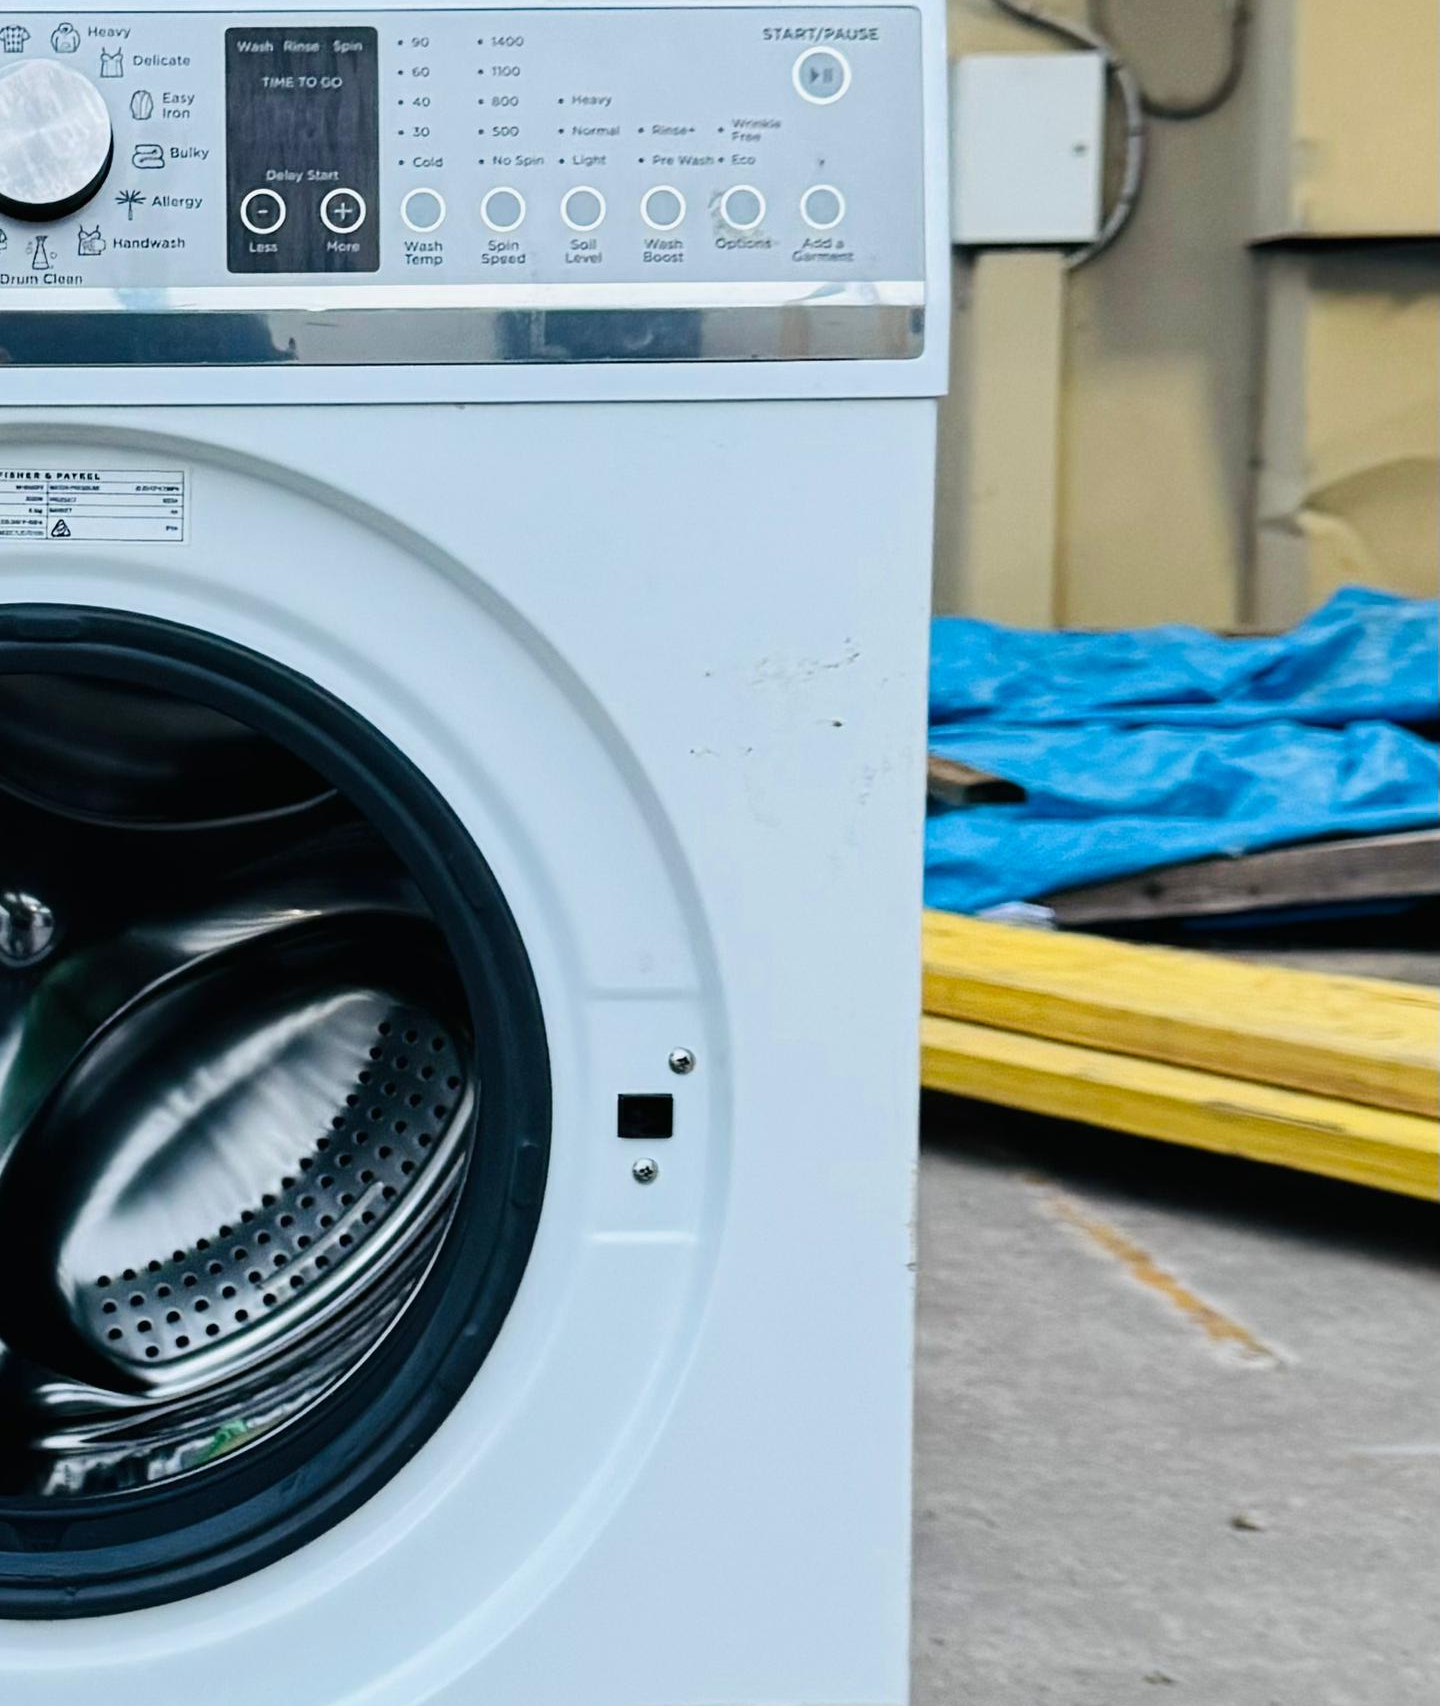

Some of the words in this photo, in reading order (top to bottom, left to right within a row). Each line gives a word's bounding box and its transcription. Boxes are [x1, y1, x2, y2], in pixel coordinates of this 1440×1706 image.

[88, 26, 131, 40] Heavy
[762, 27, 879, 42] START/PAUSE
[237, 41, 274, 53] Wash
[283, 41, 320, 53] Rinse
[333, 40, 363, 54] Spin
[492, 36, 525, 47] 1400
[132, 54, 191, 67] Delicate
[412, 67, 430, 78] 60
[492, 66, 521, 77] 1100
[262, 77, 294, 89] TIME
[298, 77, 318, 88] TO
[320, 77, 343, 88] GO
[162, 92, 195, 106] Easy
[412, 97, 431, 108] 40
[491, 96, 519, 107] 800
[162, 107, 191, 119] Iron
[413, 127, 430, 138] 30
[492, 126, 520, 137] 500
[170, 147, 210, 161] Bulky
[731, 154, 756, 165] Eco
[413, 156, 444, 168] Cold
[492, 156, 511, 166] No
[515, 155, 545, 168] Spin
[572, 155, 607, 168] Light
[266, 169, 303, 183] Delay
[307, 169, 339, 181] Start
[151, 195, 203, 210] Allergy
[113, 236, 186, 250] Handwash
[249, 242, 278, 254] Less
[327, 242, 360, 253] More
[404, 240, 443, 253] Wash
[488, 239, 520, 253] Spin
[644, 239, 684, 249] Wash
[404, 253, 443, 267] Temp
[481, 253, 526, 267] Speed
[643, 251, 684, 263] Boost
[0, 273, 39, 285] Drum
[43, 273, 83, 285] Clean
